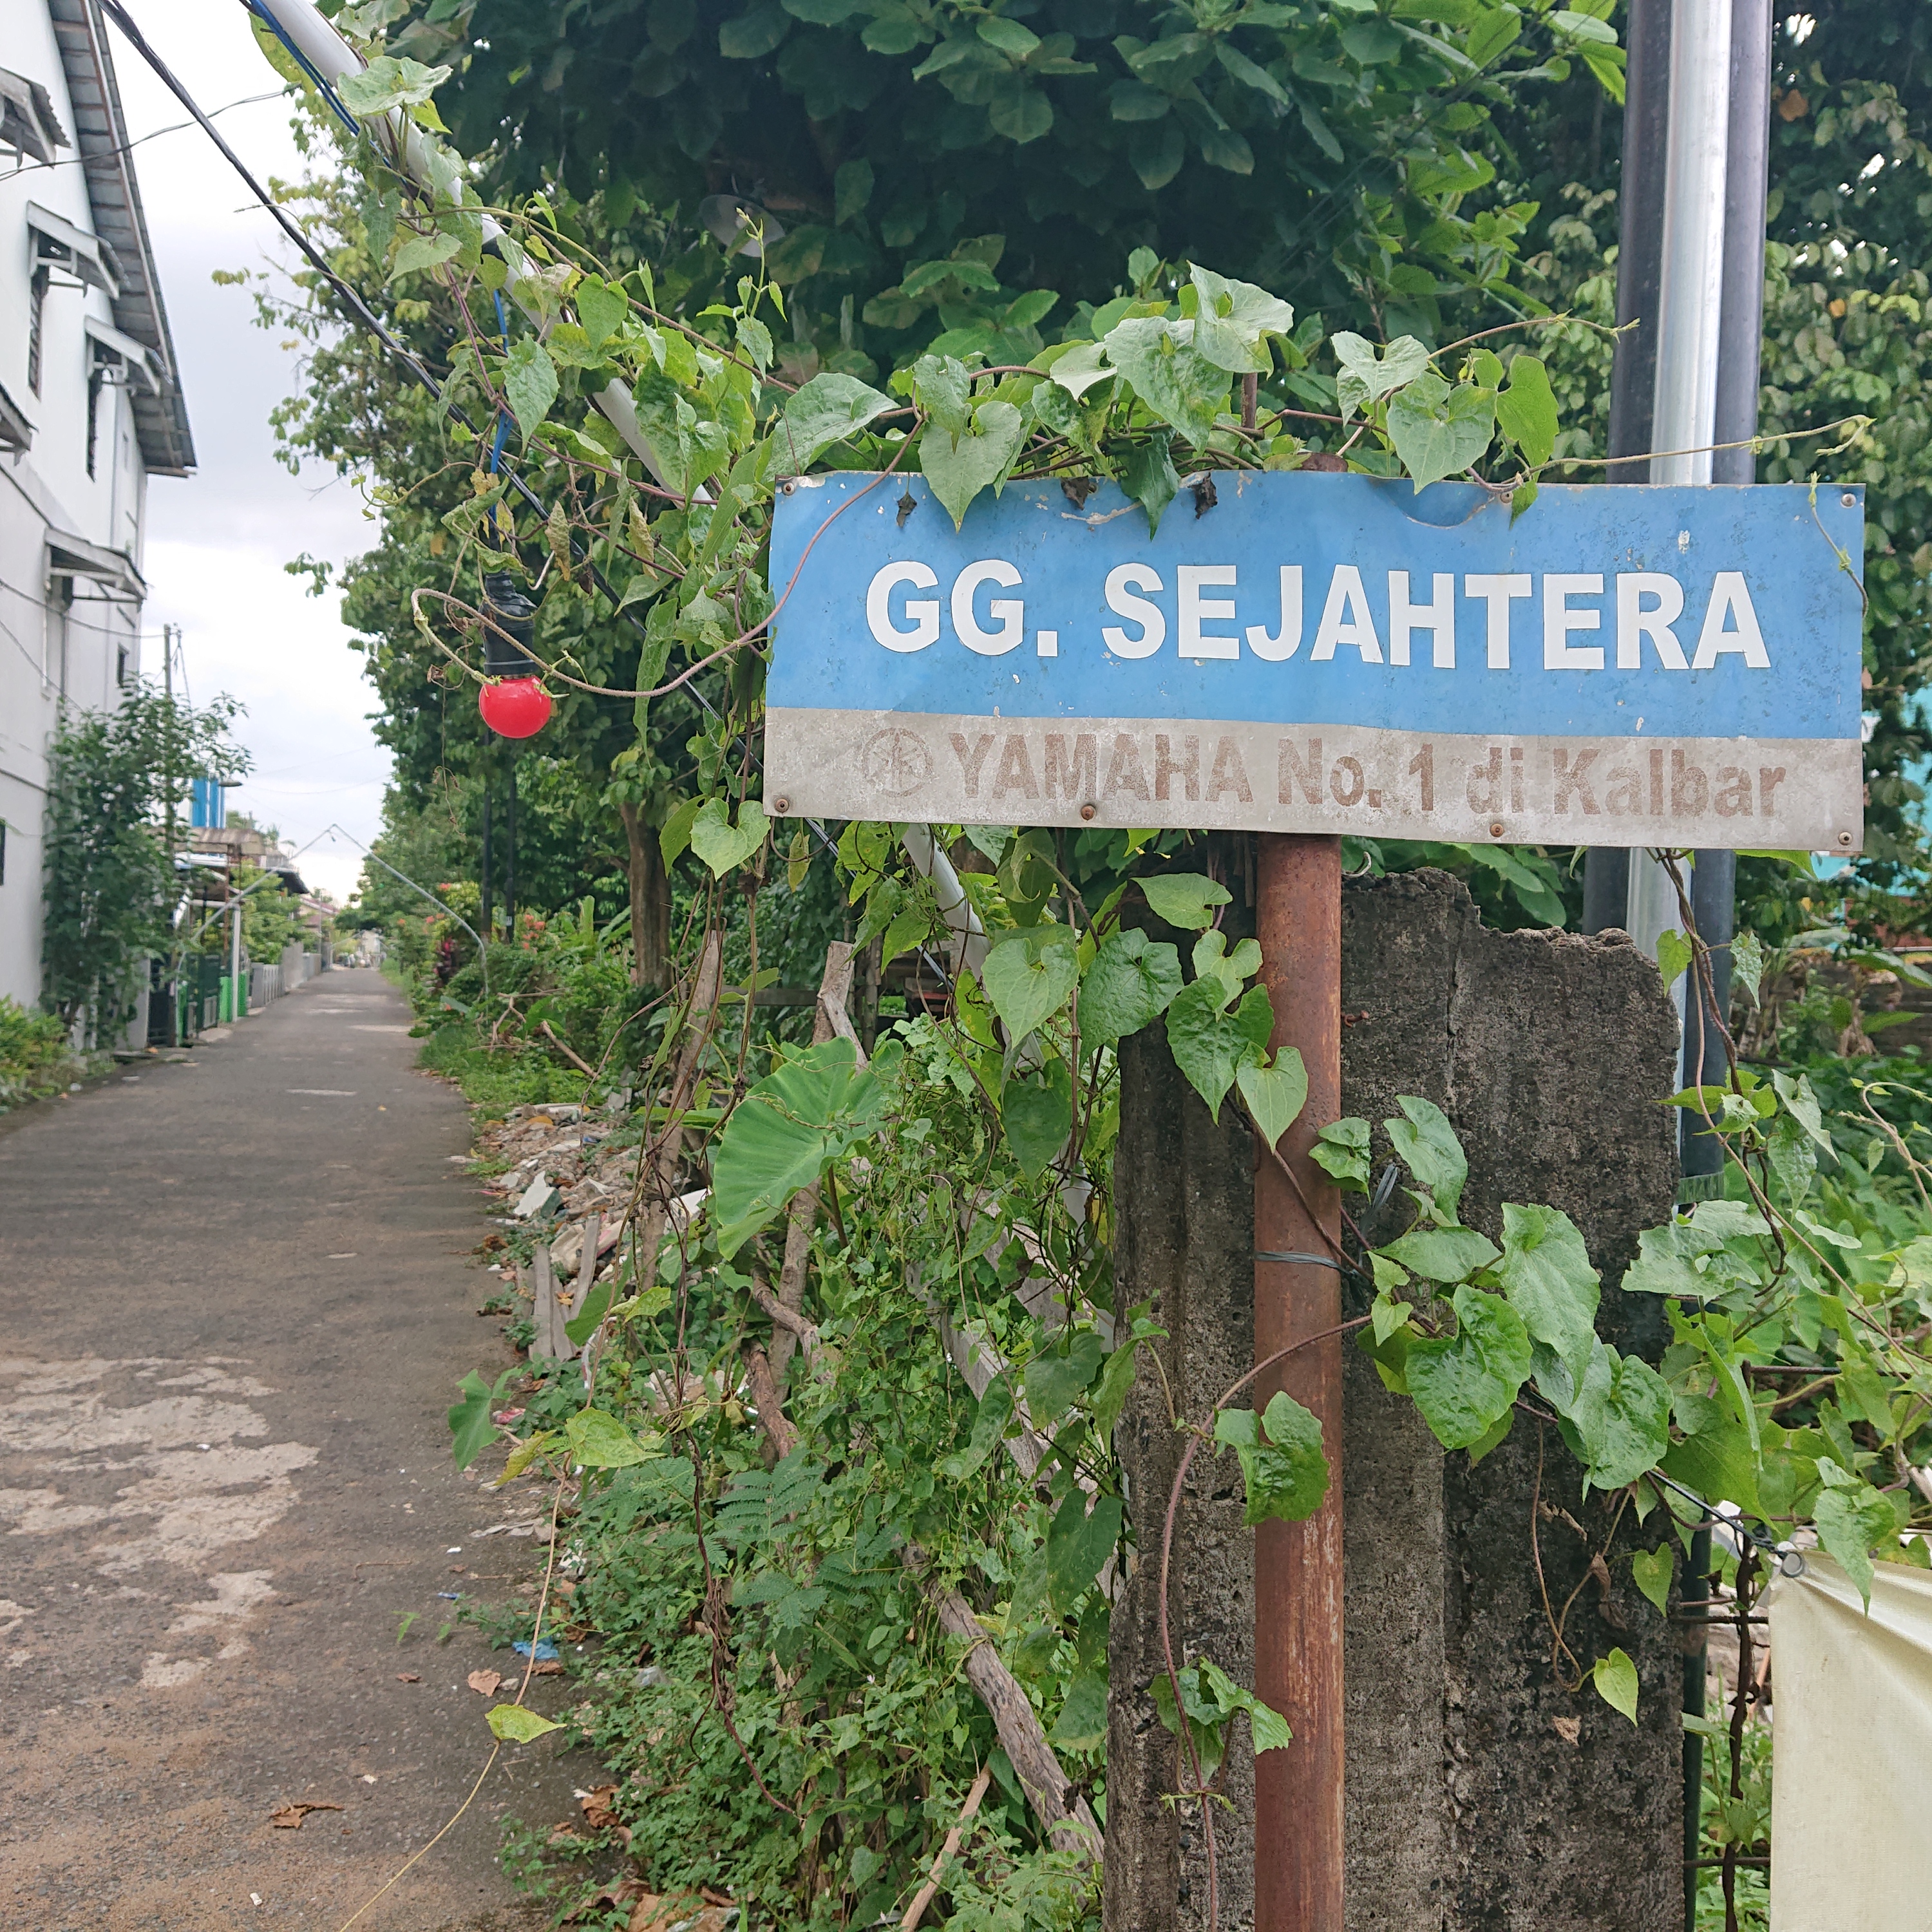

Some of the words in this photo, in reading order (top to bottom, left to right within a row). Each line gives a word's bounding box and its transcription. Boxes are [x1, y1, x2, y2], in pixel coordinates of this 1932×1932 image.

[866, 560, 1059, 658] GG.
[1101, 562, 1772, 670] SEJAHTERA
[949, 732, 1253, 804] YAMAHA
[1277, 737, 1383, 809] No.
[1407, 743, 1435, 811] 1
[1465, 746, 1524, 814] di
[1552, 748, 1786, 818] Kalbar
